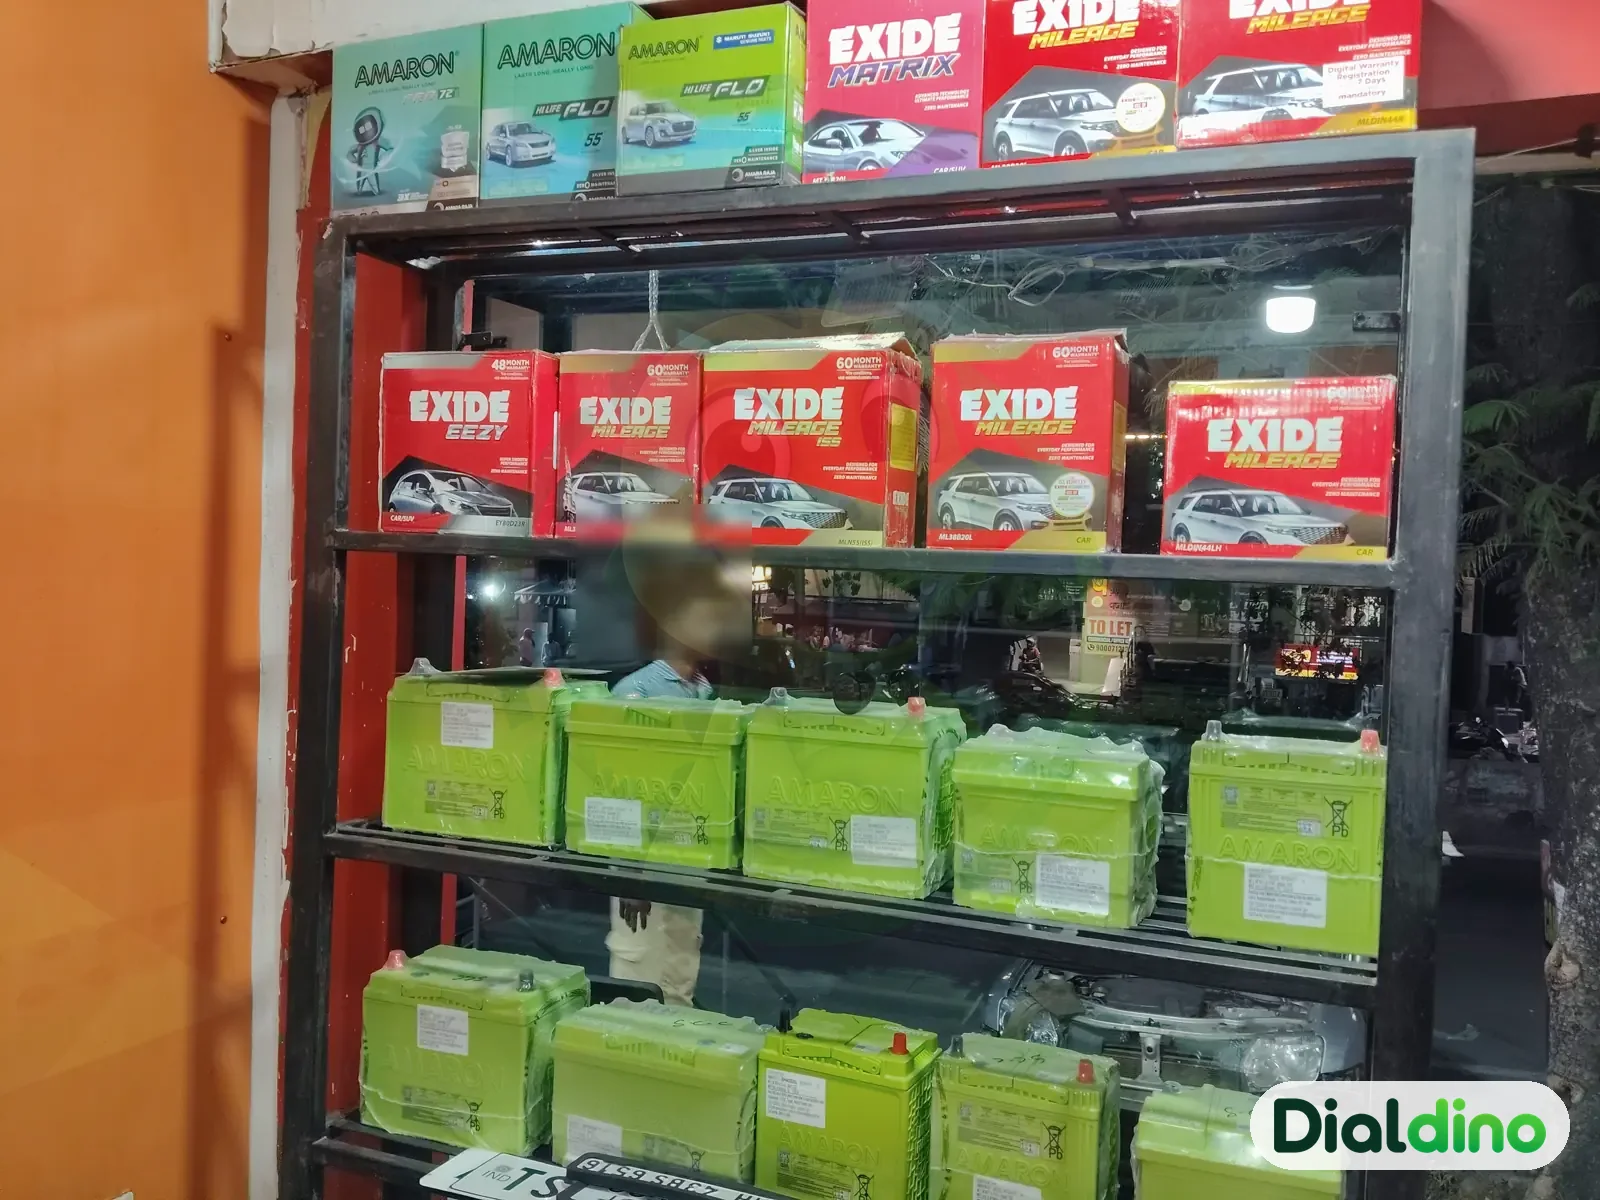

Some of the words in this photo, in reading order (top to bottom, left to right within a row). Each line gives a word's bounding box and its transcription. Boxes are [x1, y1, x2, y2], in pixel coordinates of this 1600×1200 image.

[1012, 0, 1140, 35] EXIDE
[1246, 4, 1371, 35] MILEAGE
[828, 12, 962, 65] EXIDE
[1029, 21, 1139, 50] MILEAGE
[497, 32, 615, 70] AMARON
[628, 38, 700, 60] AMARON
[355, 51, 454, 88] AMARON
[827, 53, 961, 88] MATRIX
[1328, 64, 1357, 74] Digital
[1359, 60, 1400, 71] Warranty
[1336, 69, 1390, 80] Registration
[1365, 77, 1386, 86] Days
[440, 88, 453, 99] 72
[1338, 90, 1386, 100] mandatory
[737, 111, 750, 122] 55
[585, 132, 603, 147] 55
[1052, 346, 1069, 359] 60
[1070, 345, 1098, 353] MONTH
[492, 359, 506, 371] 48
[836, 357, 853, 369] 60
[854, 356, 882, 364] MONTH
[647, 364, 663, 376] 60
[409, 390, 510, 422] EXIDE
[580, 396, 672, 425] EXIDE
[733, 387, 844, 420] EXIDE
[960, 386, 1079, 421] EXIDE
[445, 424, 509, 441] EEZY
[591, 425, 670, 439] MILEAGE
[747, 420, 842, 436] MILEAGE
[974, 420, 1076, 436] MILEAGE
[1207, 416, 1344, 453] EXIDE
[1224, 452, 1341, 469] MILEAGE
[390, 514, 415, 522] CAR/SUV
[1076, 536, 1091, 544] CAR
[1356, 548, 1373, 556] CAR
[1090, 620, 1106, 634] TO
[1109, 620, 1133, 636] LET
[765, 775, 904, 816] AMARON
[494, 807, 505, 820] Pb
[1332, 824, 1348, 838] Pb
[697, 834, 709, 845] Pb
[835, 840, 848, 851] Pb
[1219, 834, 1359, 872] AMARON
[1019, 882, 1033, 894] Pb
[1049, 1148, 1063, 1160] Pb
[481, 1171, 511, 1182] IND
